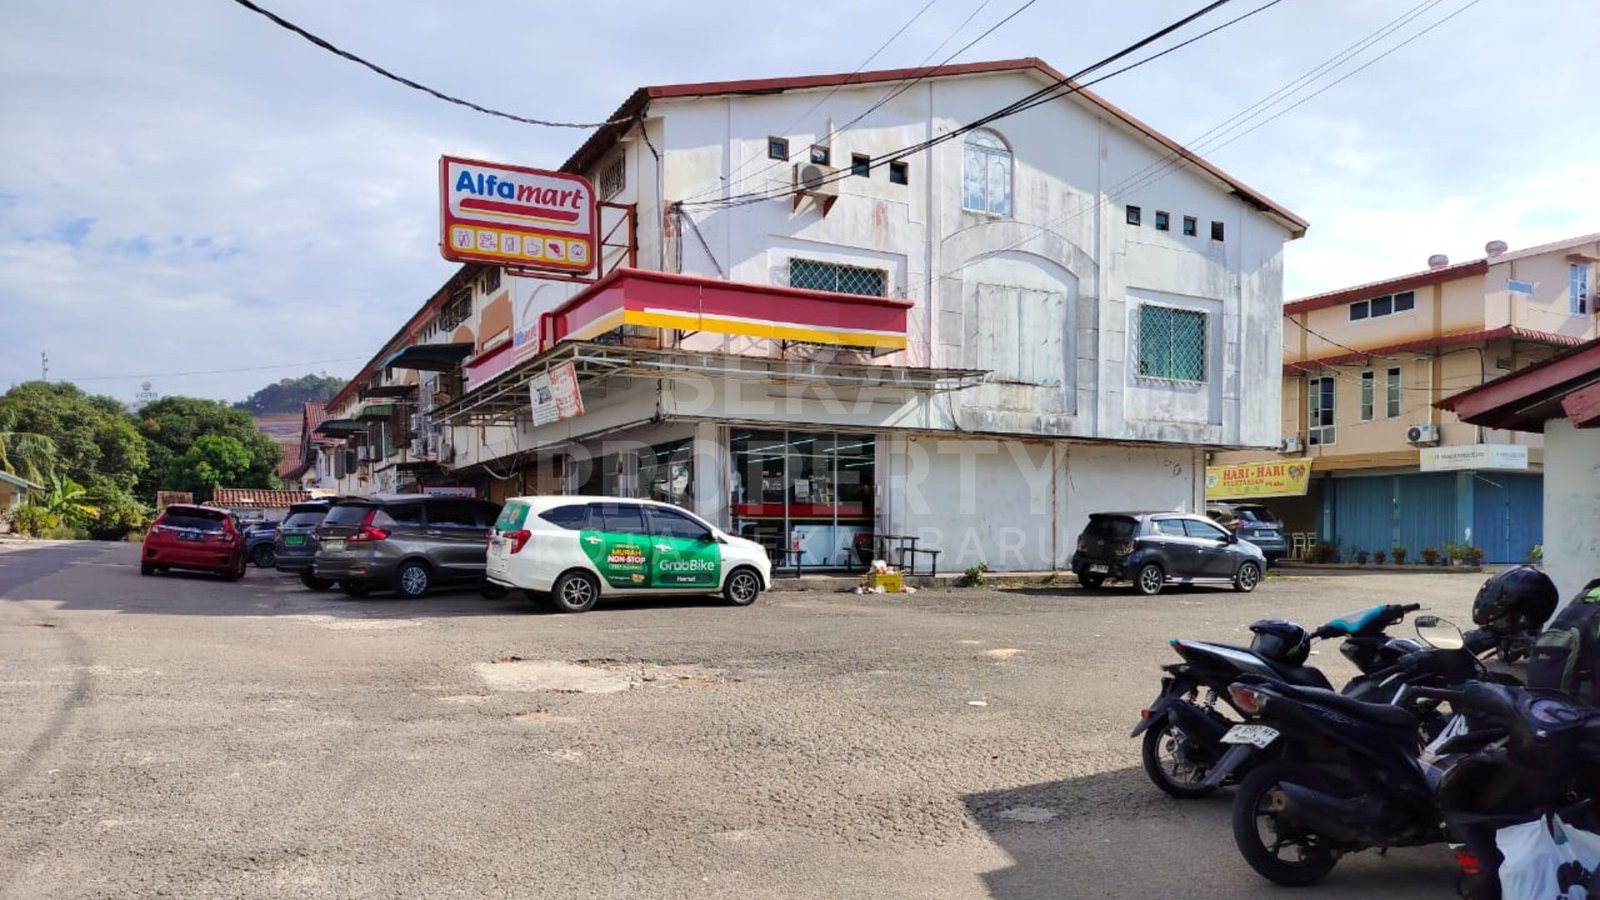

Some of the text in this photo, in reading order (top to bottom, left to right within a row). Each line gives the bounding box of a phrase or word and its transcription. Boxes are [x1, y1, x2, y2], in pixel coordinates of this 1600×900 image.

[455, 170, 584, 210] Alfamart
[1223, 465, 1284, 480] HARI HARI
[607, 555, 646, 564] NON-STOP
[659, 559, 715, 571] GrabBike
